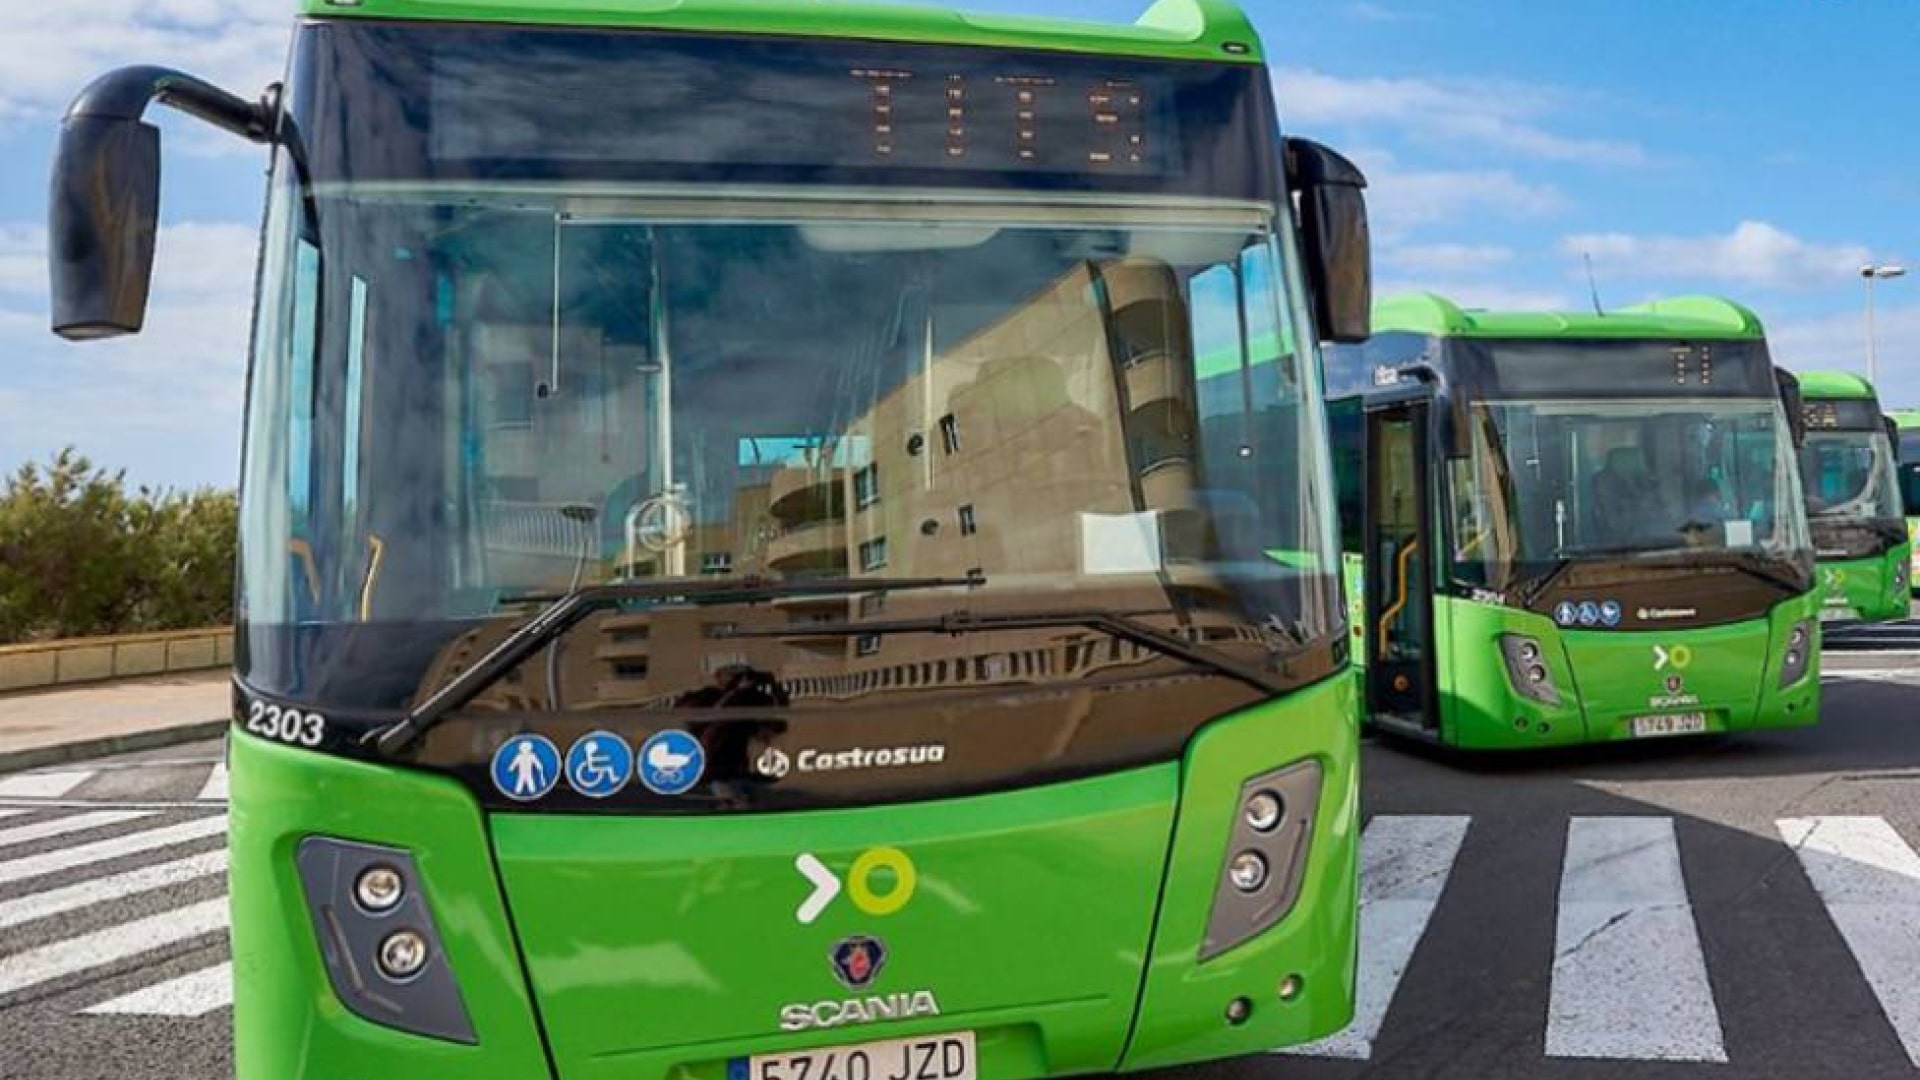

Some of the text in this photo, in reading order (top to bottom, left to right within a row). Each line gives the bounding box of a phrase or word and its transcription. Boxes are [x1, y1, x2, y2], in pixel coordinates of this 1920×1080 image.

[248, 700, 325, 746] 2303
[798, 744, 945, 771] Castrosua
[779, 990, 940, 1030] SCANIA
[888, 1038, 965, 1080] JZD
